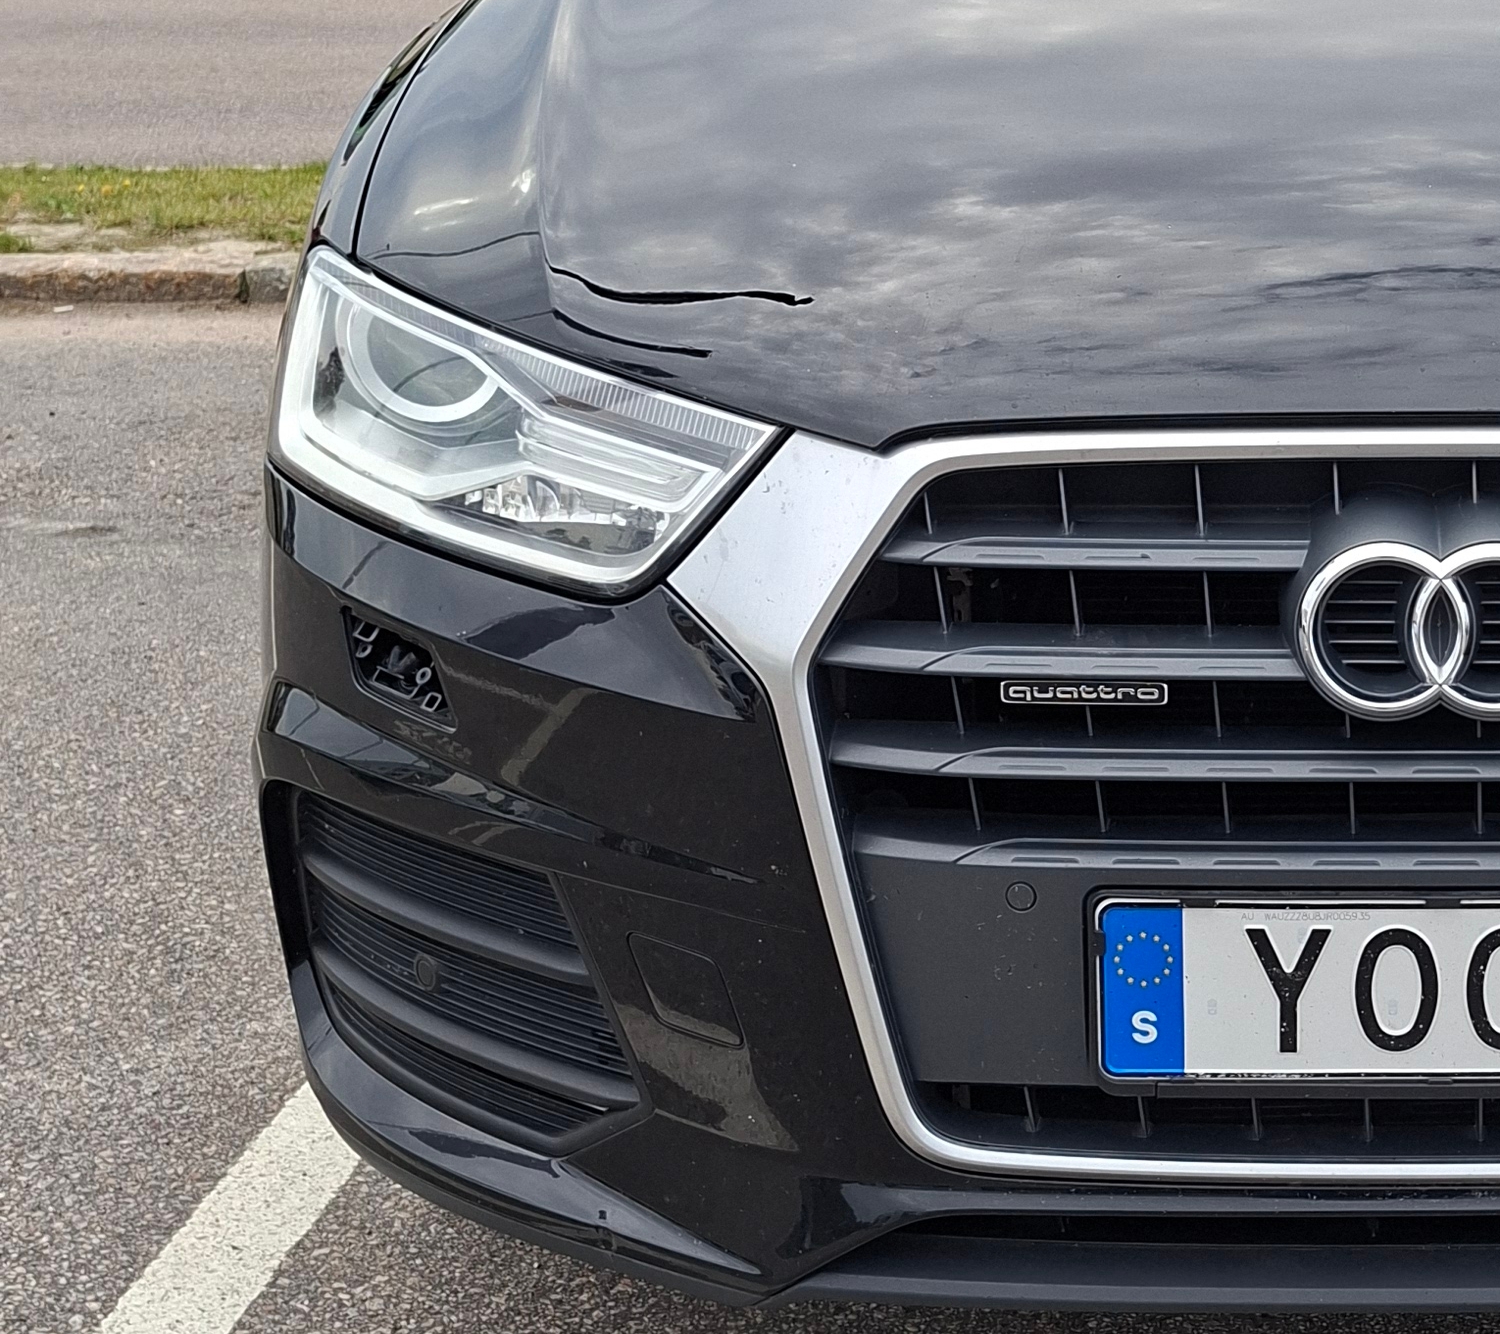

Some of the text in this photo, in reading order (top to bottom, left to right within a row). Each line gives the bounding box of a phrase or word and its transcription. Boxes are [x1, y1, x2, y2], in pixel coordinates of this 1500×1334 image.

[1008, 684, 1160, 702] quattro
[1240, 911, 1255, 922] AU
[1131, 1010, 1158, 1045] S
